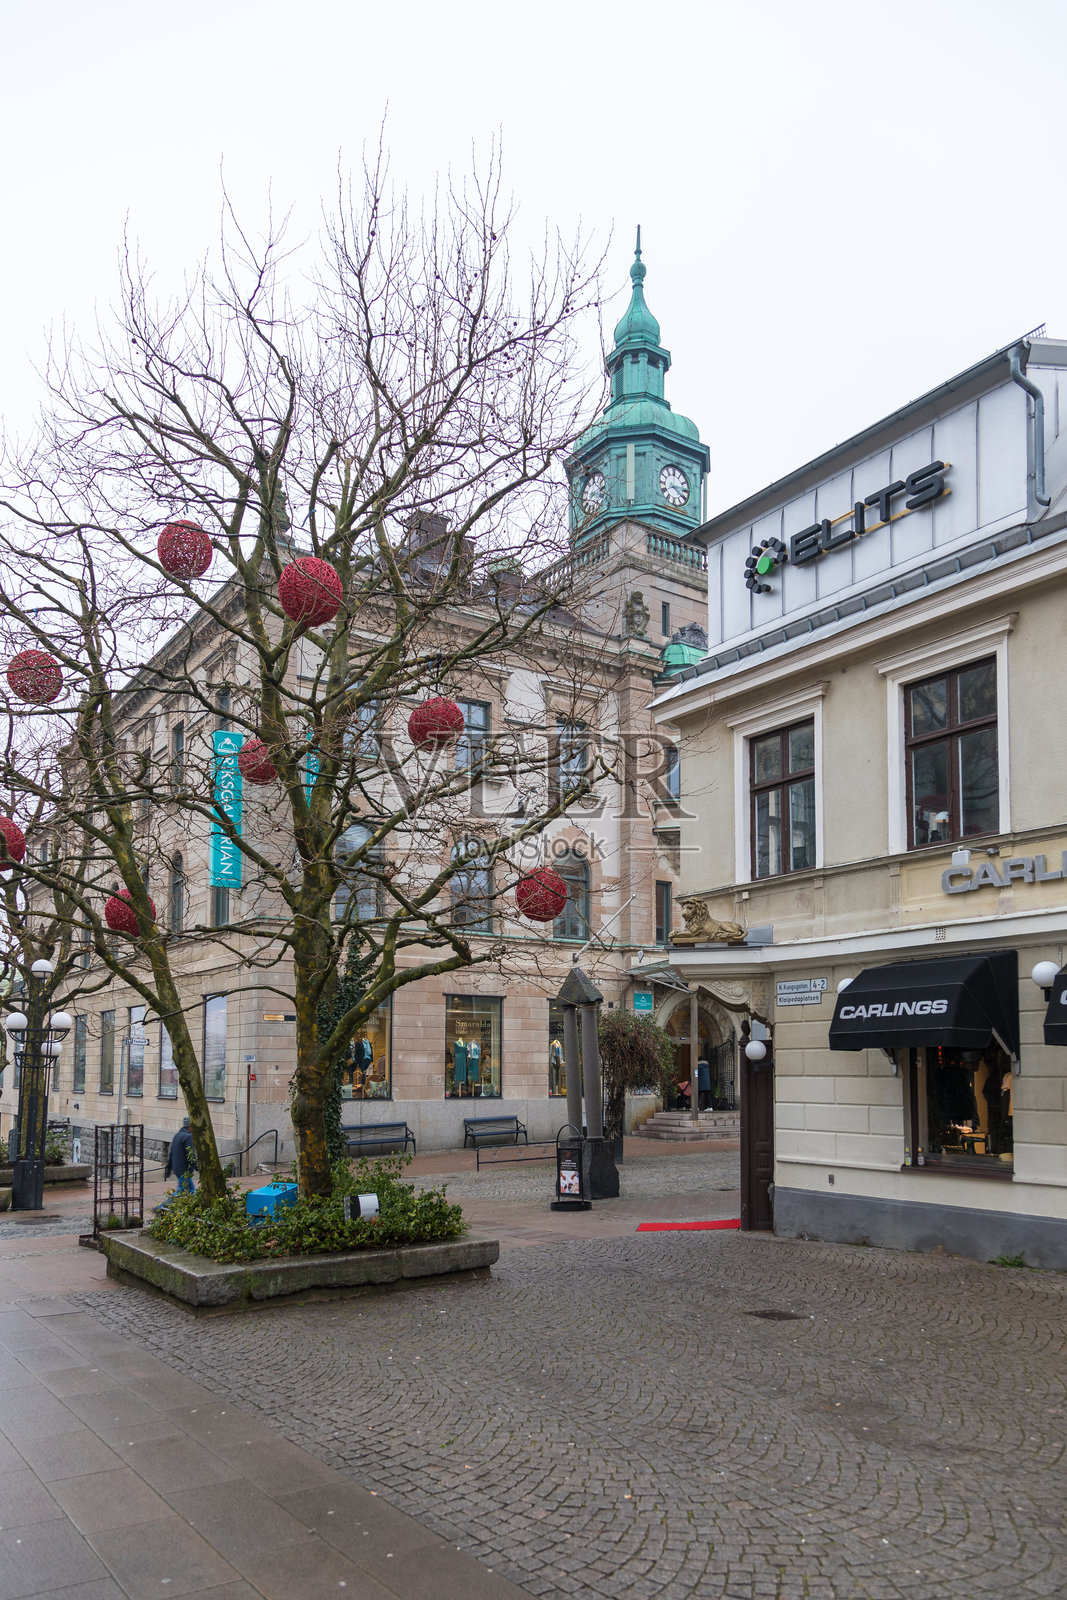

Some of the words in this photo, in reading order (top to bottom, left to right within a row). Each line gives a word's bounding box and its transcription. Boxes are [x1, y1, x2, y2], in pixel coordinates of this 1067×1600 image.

[790, 460, 944, 566] ELITS
[812, 980, 826, 989] 4-2
[839, 999, 948, 1020] CARLINGS
